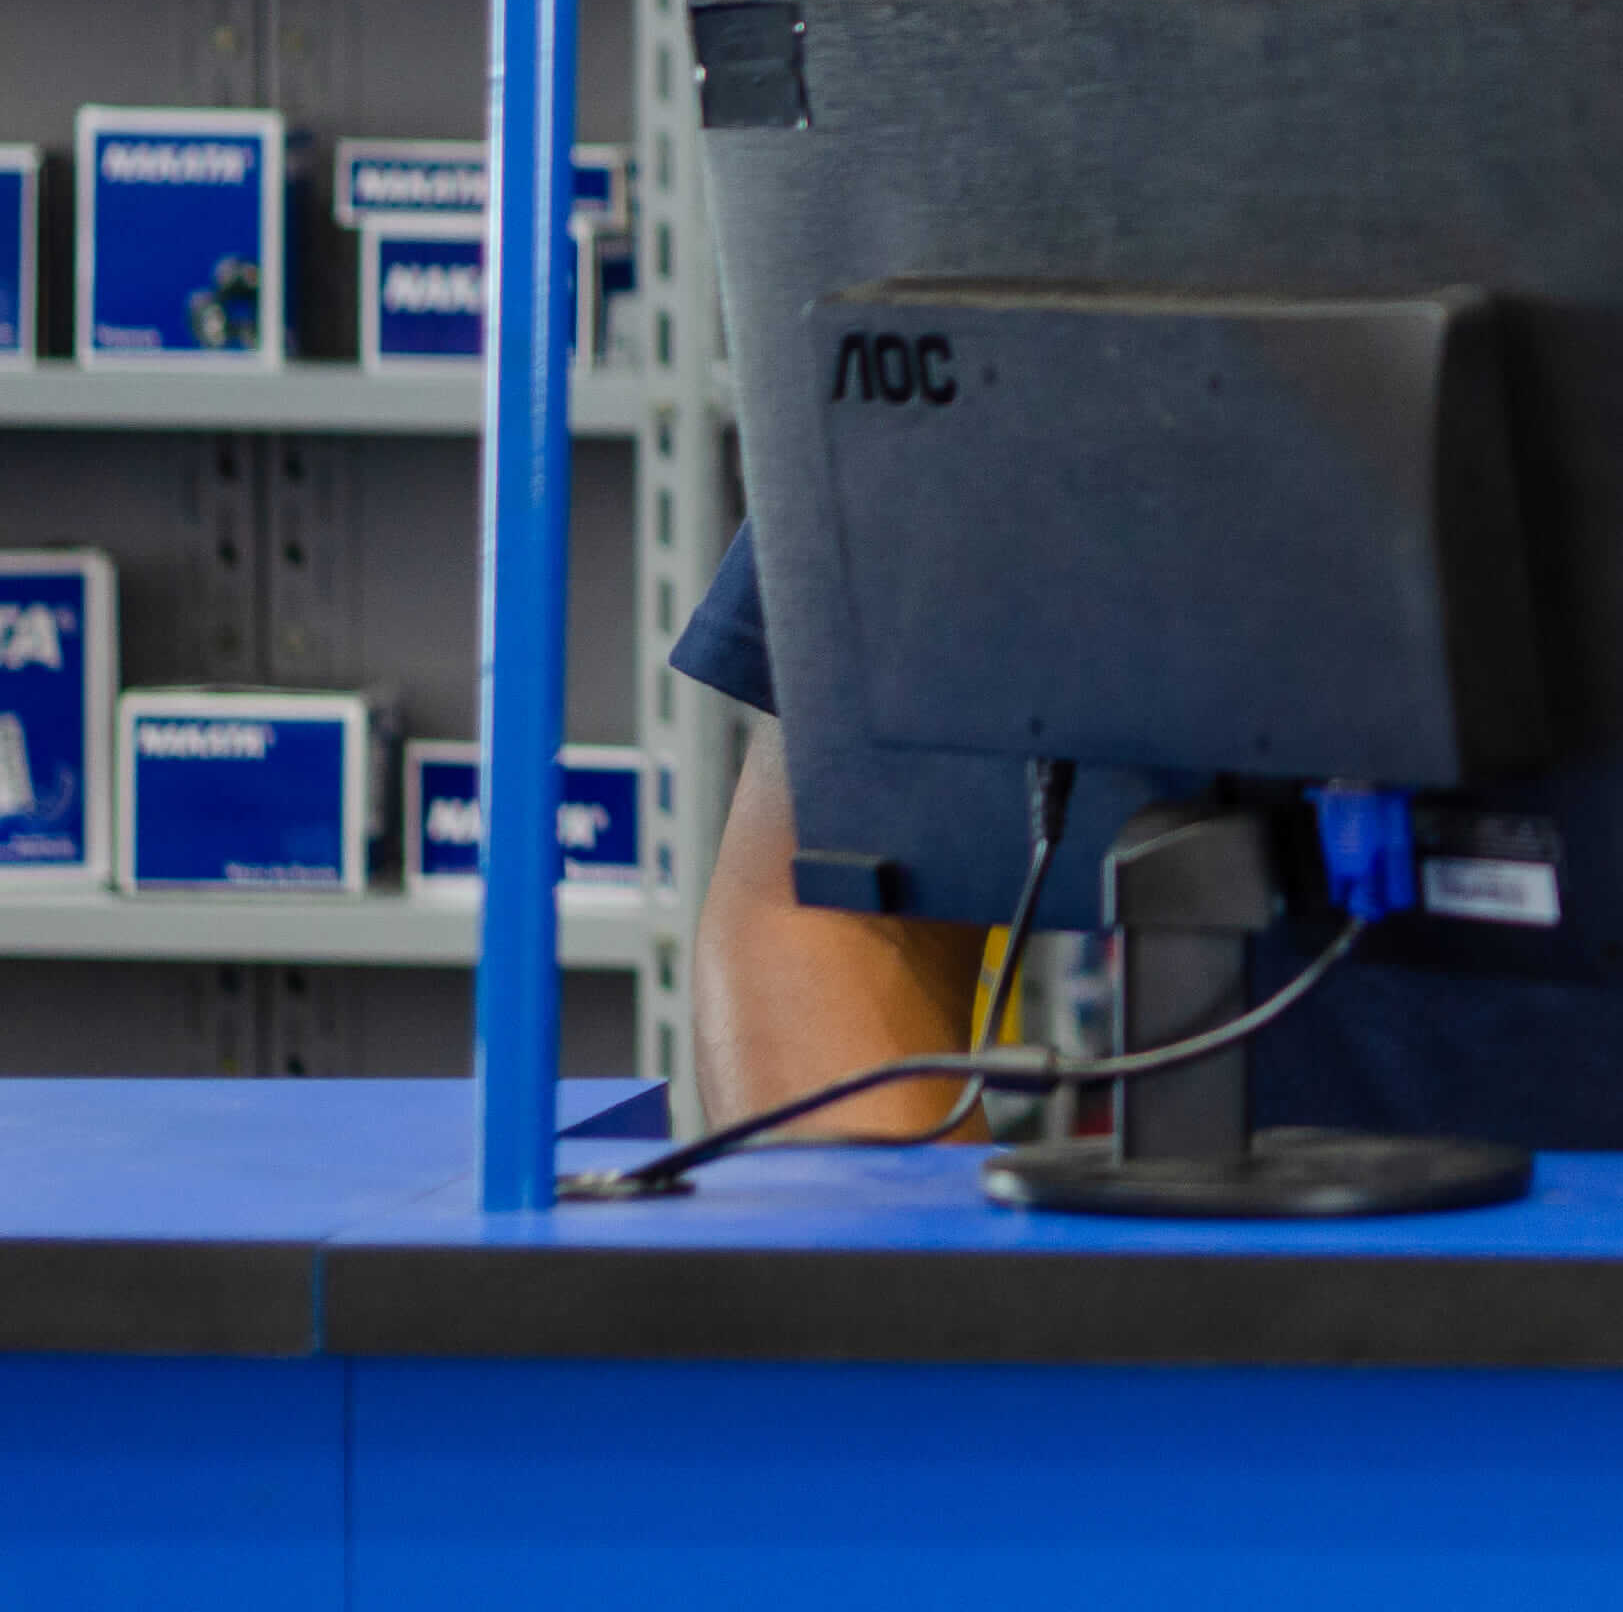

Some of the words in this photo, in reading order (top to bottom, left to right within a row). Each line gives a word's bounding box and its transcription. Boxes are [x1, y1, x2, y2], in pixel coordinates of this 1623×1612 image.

[102, 143, 245, 184] NAKATA
[831, 332, 957, 405] AOC
[138, 722, 266, 759] NAKATA
